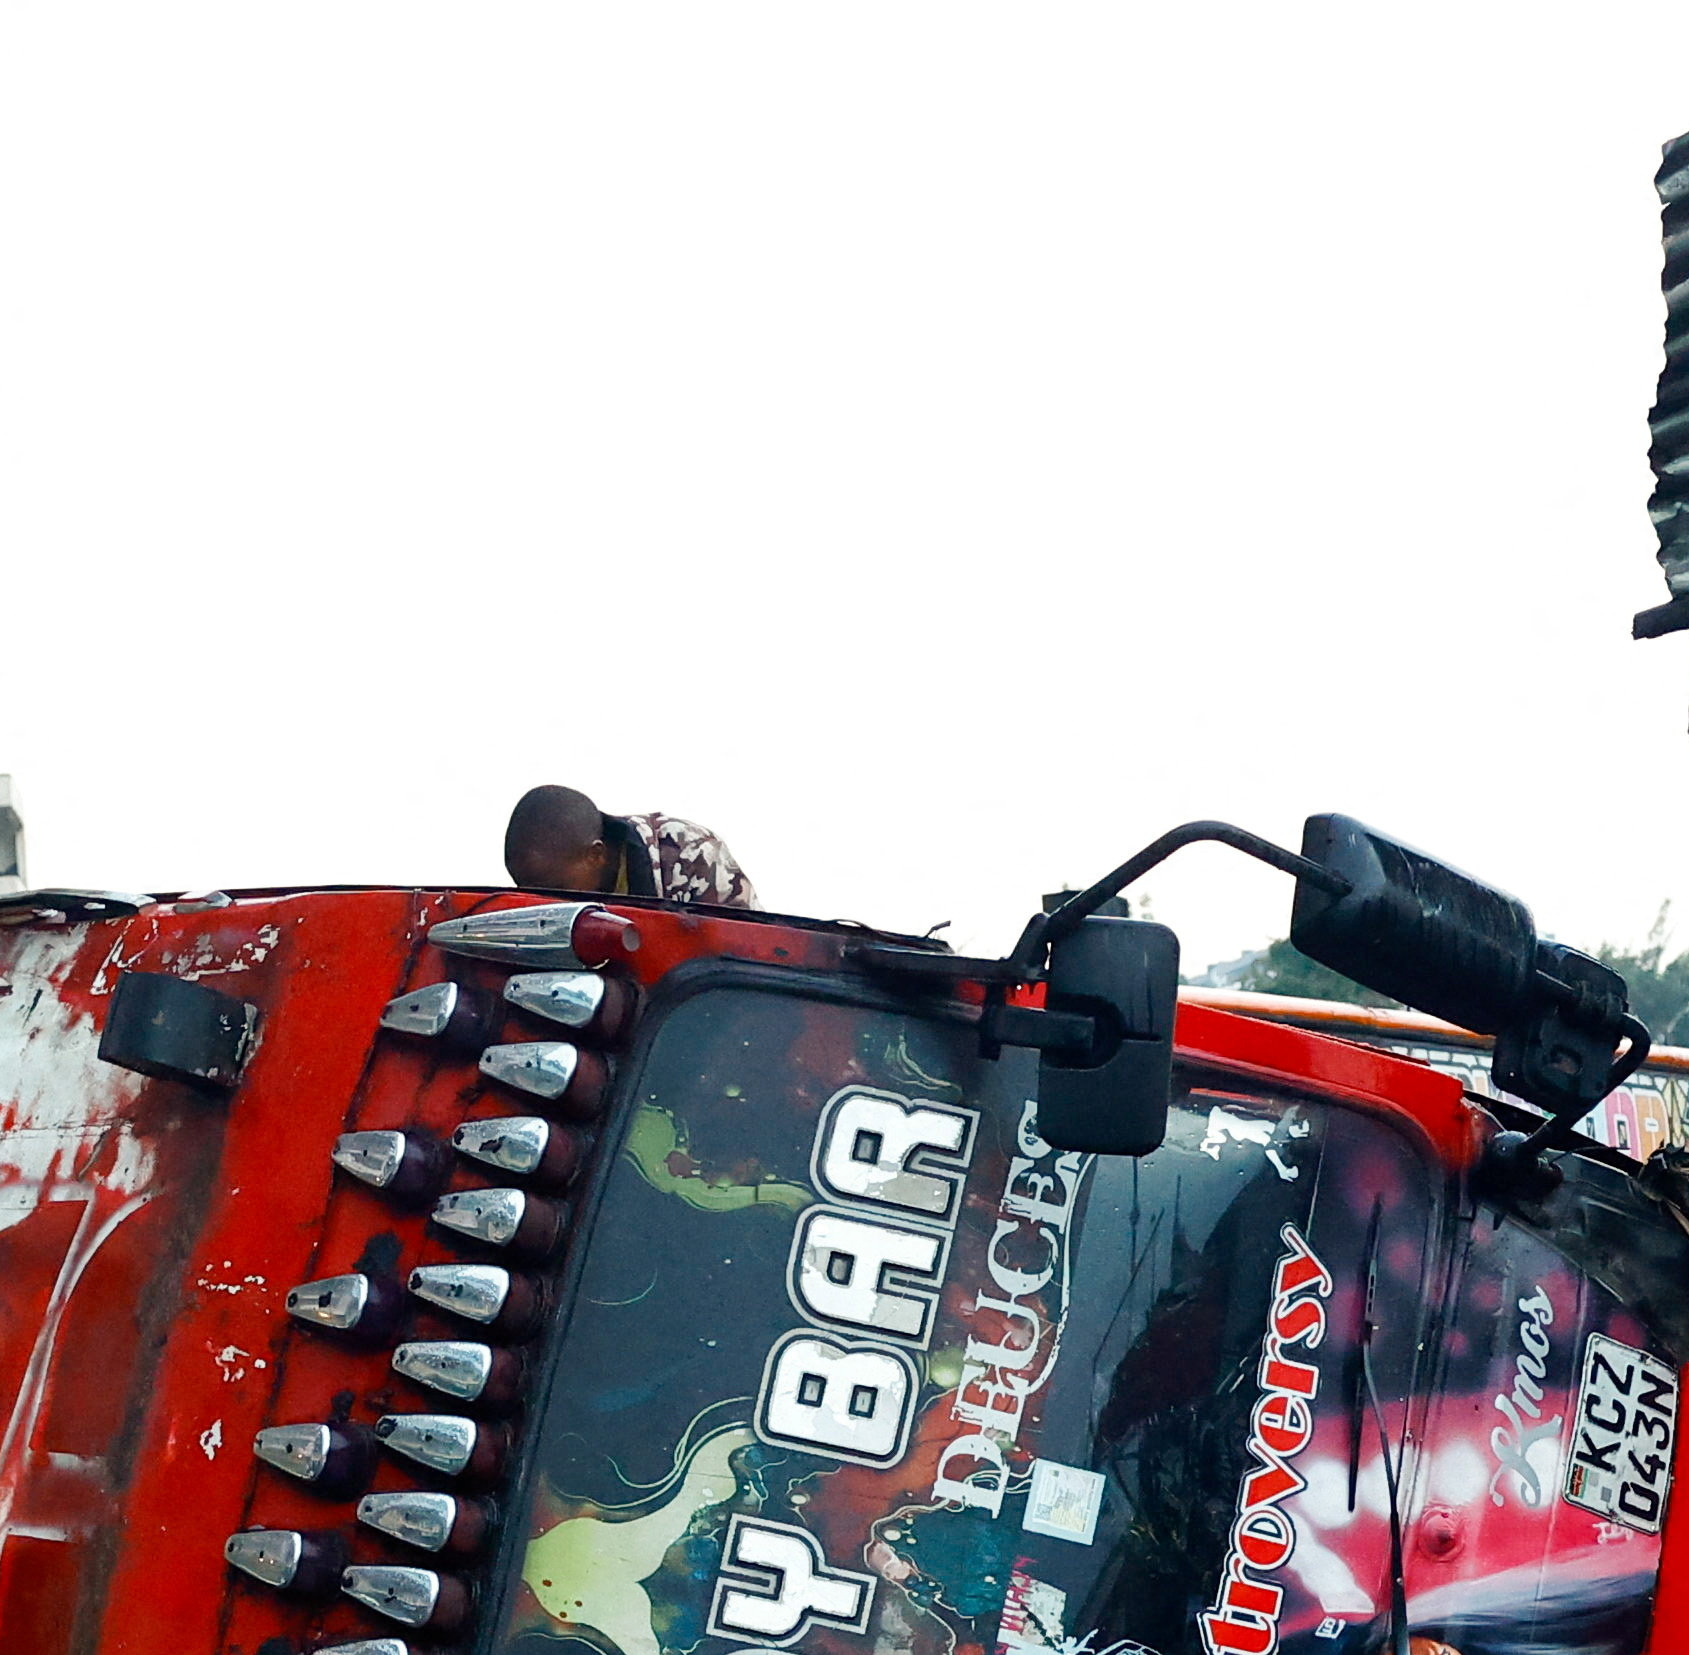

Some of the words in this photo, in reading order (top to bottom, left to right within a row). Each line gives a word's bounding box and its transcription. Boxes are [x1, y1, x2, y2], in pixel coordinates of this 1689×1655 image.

[754, 1084, 981, 1470] BAR
[1575, 1351, 1635, 1474] KCZ
[1618, 1371, 1675, 1522] 043N
